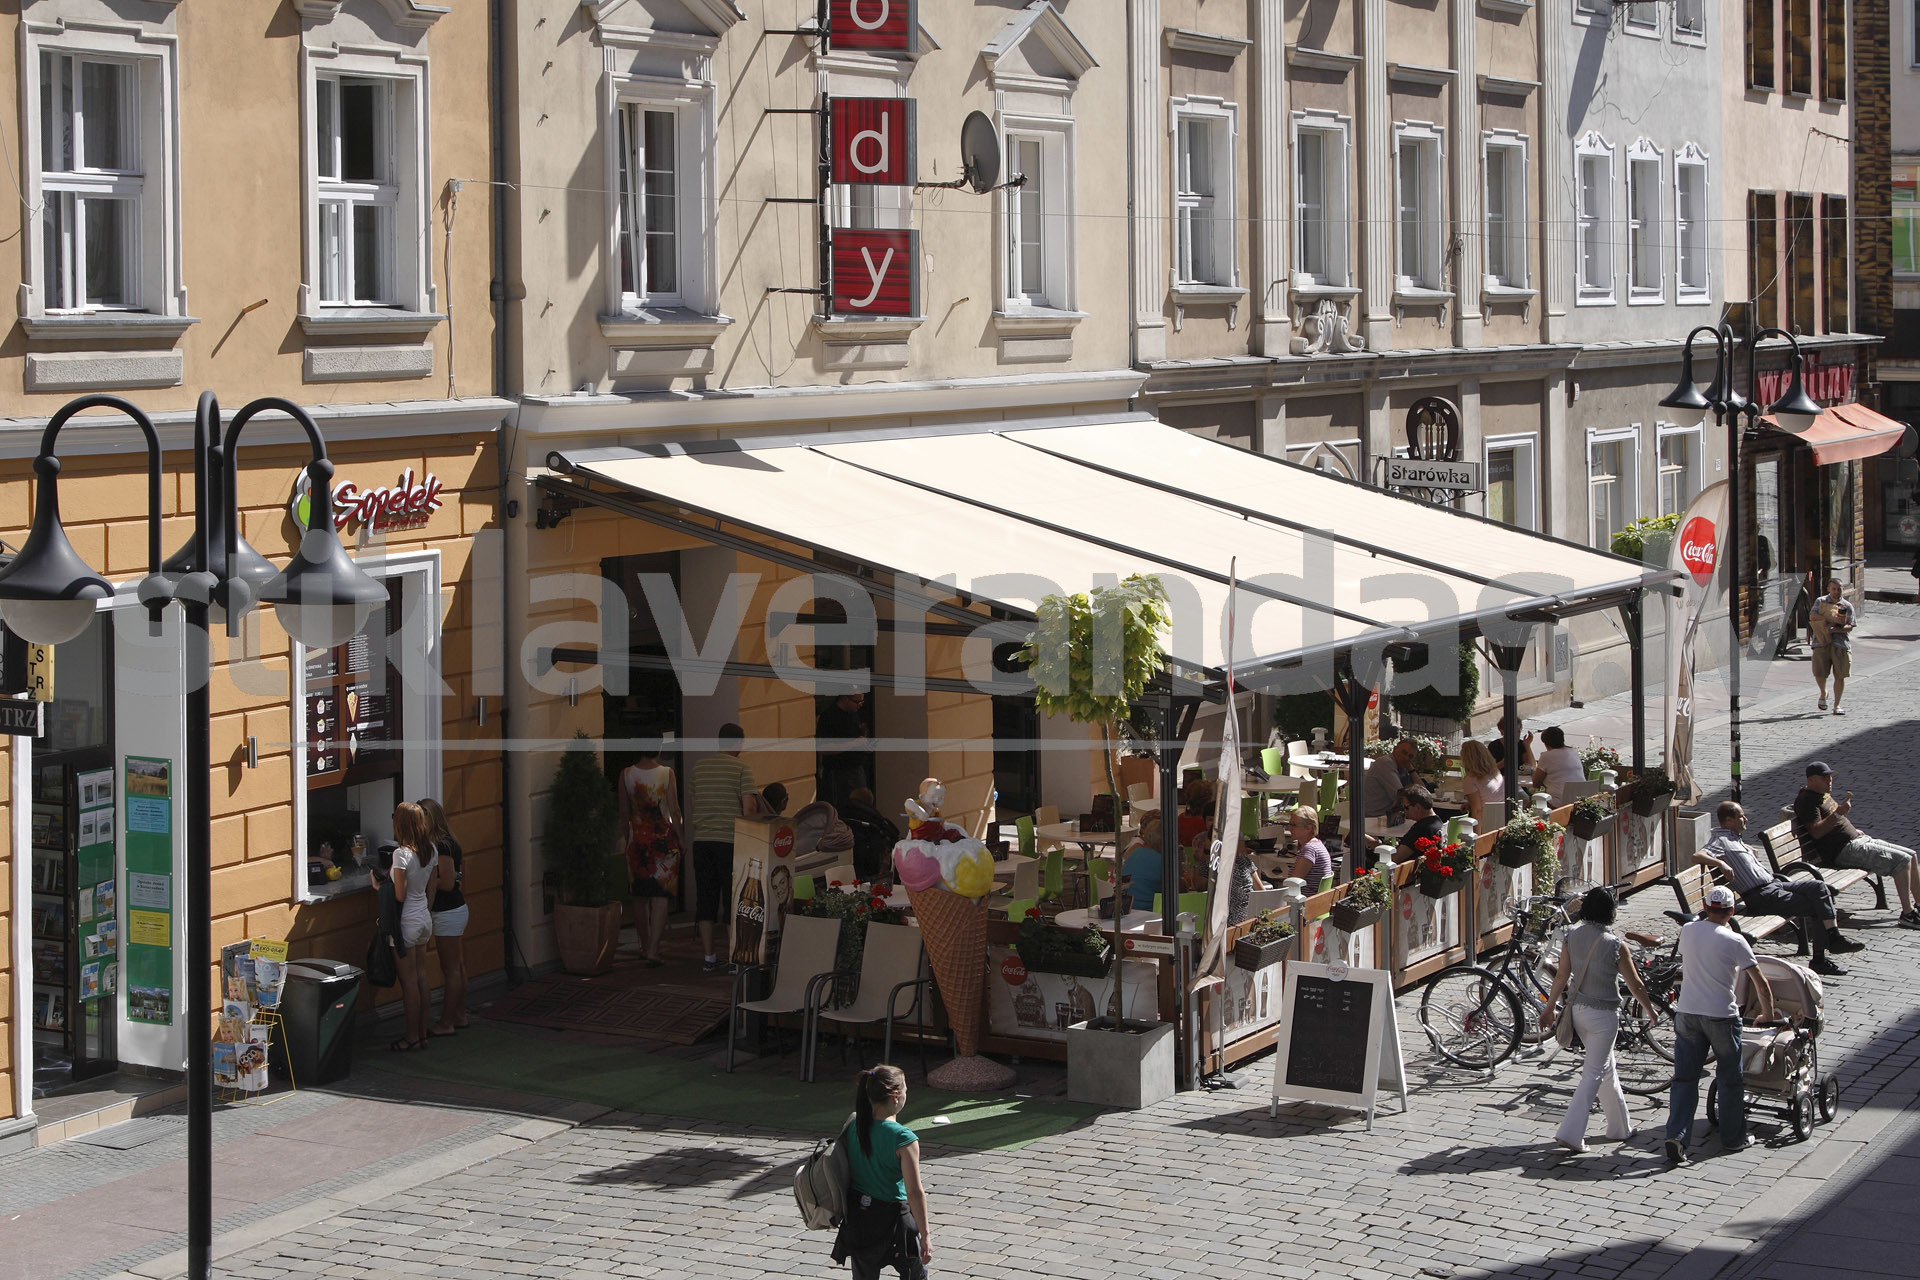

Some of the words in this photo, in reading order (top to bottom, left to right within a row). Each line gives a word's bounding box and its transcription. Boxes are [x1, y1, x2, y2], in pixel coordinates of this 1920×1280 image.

[1391, 464, 1470, 484] Starówka
[333, 469, 443, 534] Sopelek
[27, 643, 45, 700] STRZ
[0, 707, 37, 728] TRZ
